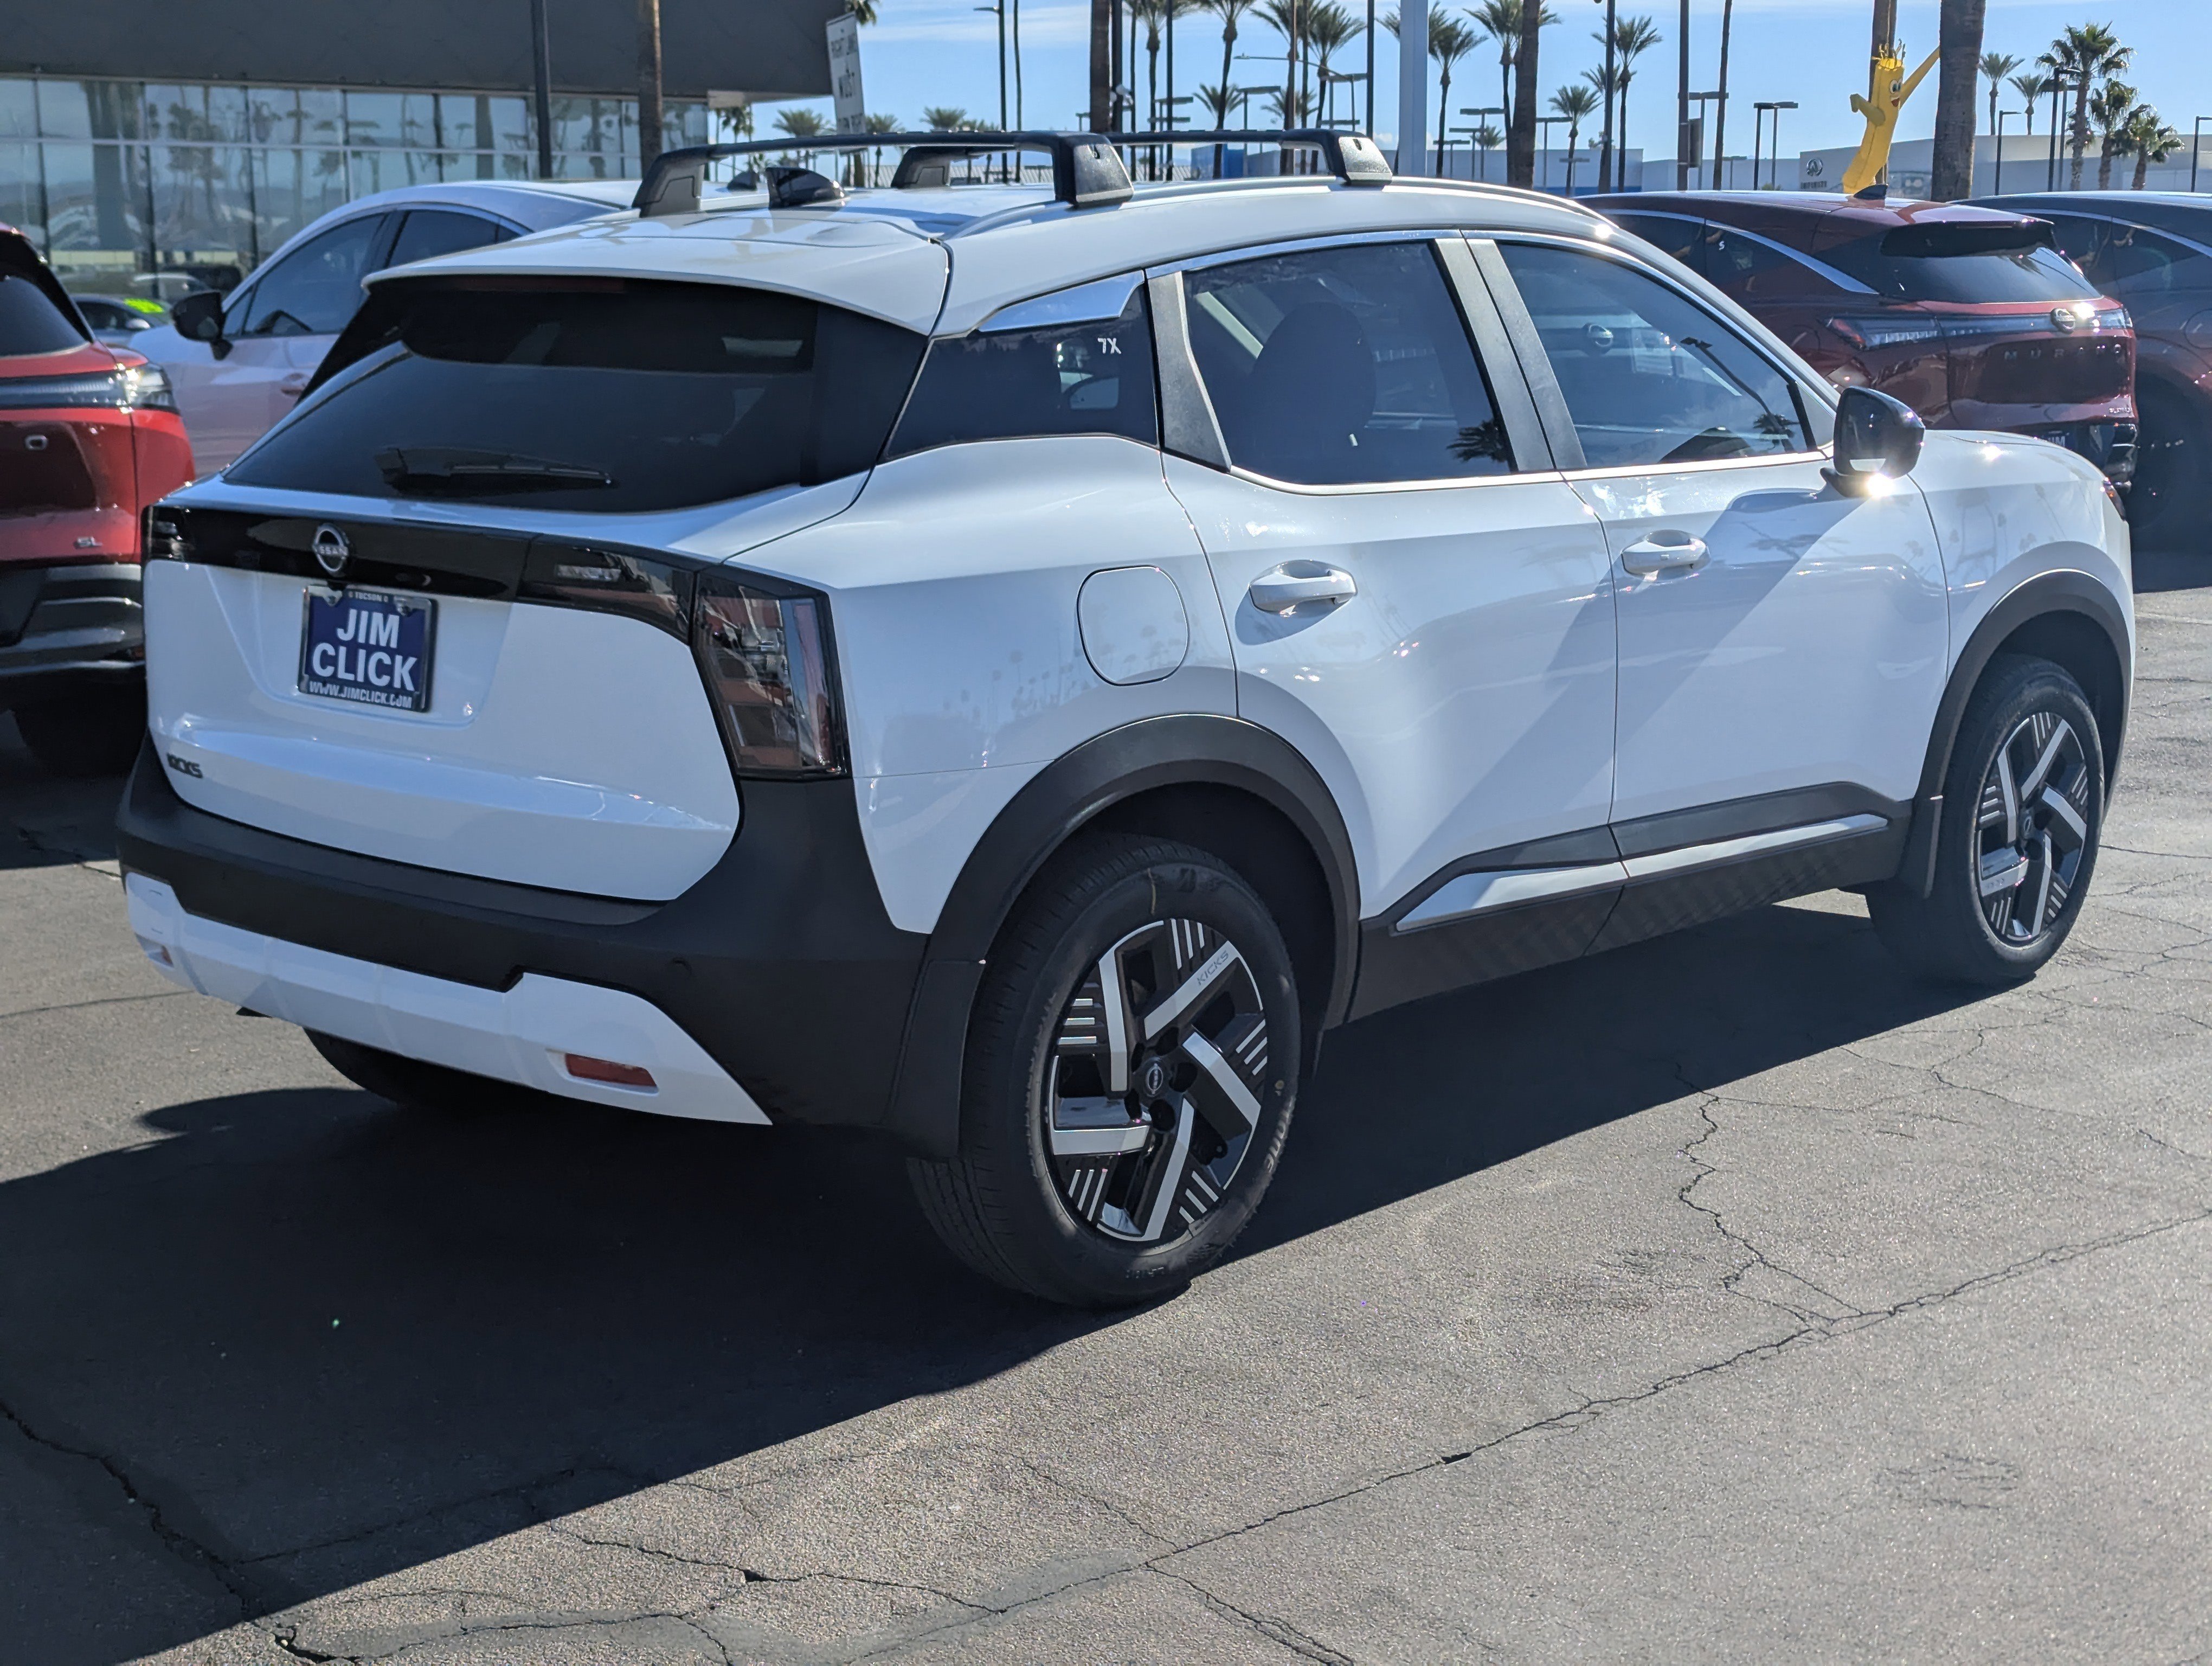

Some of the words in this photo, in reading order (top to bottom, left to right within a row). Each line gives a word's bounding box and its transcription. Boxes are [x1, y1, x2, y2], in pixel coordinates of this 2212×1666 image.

[1097, 337, 1122, 354] 7X
[336, 608, 400, 649] JIM
[312, 642, 417, 691] CLICK
[309, 680, 413, 709] WWW.JIMCLICK.COM
[1197, 950, 1229, 986] KICKS
